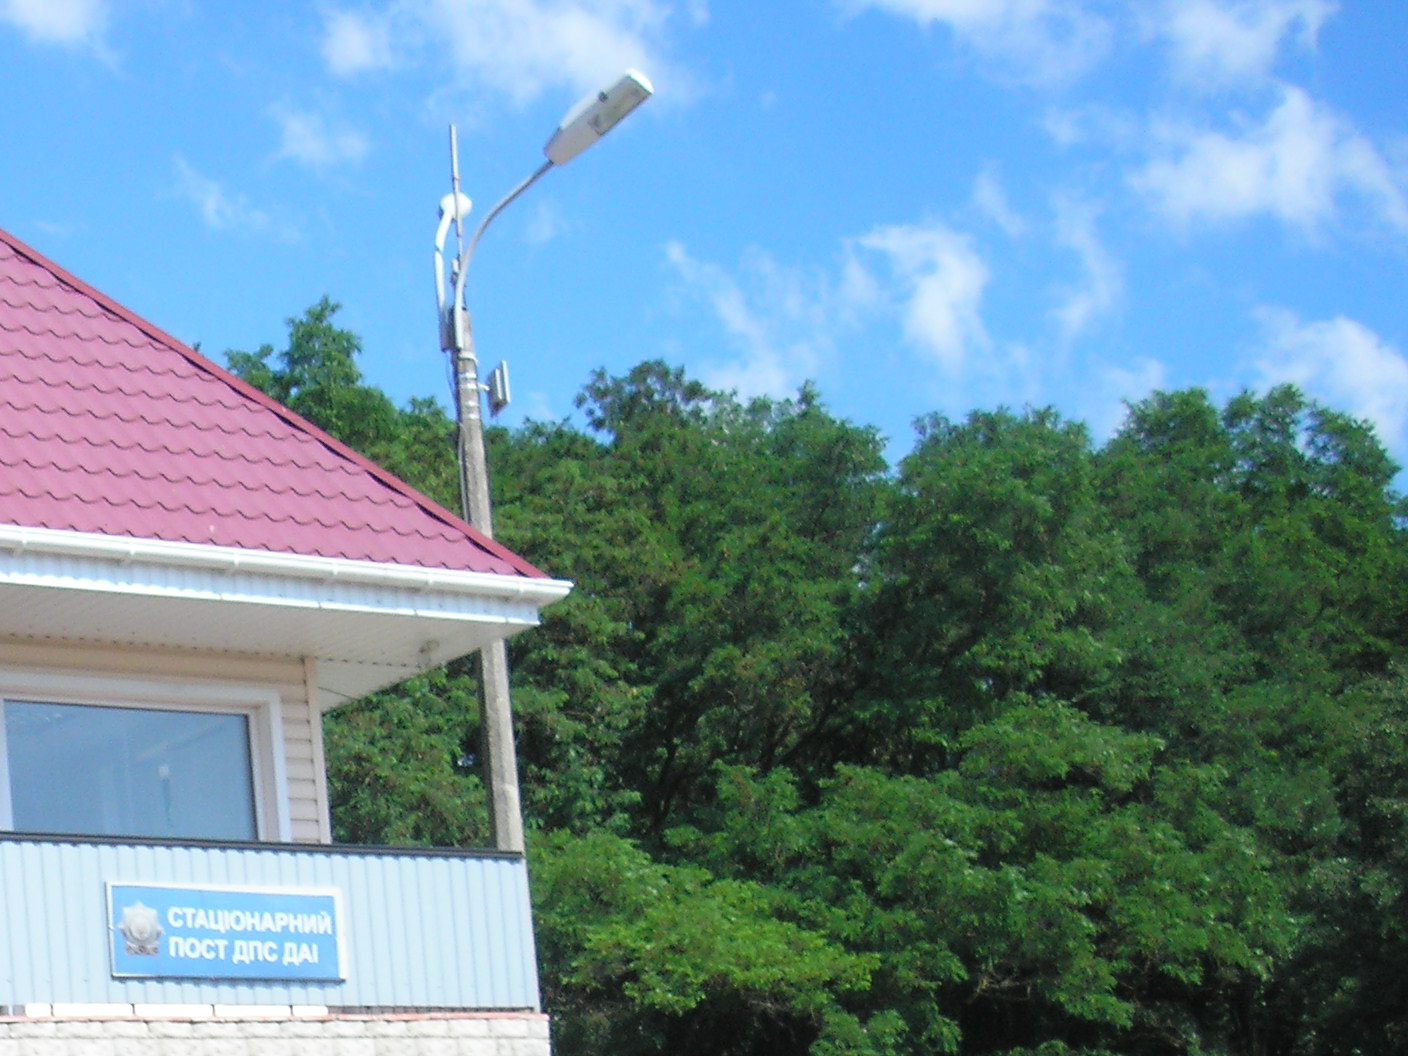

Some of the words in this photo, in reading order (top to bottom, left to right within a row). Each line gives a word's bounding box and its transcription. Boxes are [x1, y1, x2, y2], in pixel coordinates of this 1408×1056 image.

[167, 907, 332, 935] СТАЦІОНАРНИЙ
[169, 936, 228, 960] ПОСТ
[232, 939, 278, 965] ДПС
[282, 943, 318, 967] ДАІ
